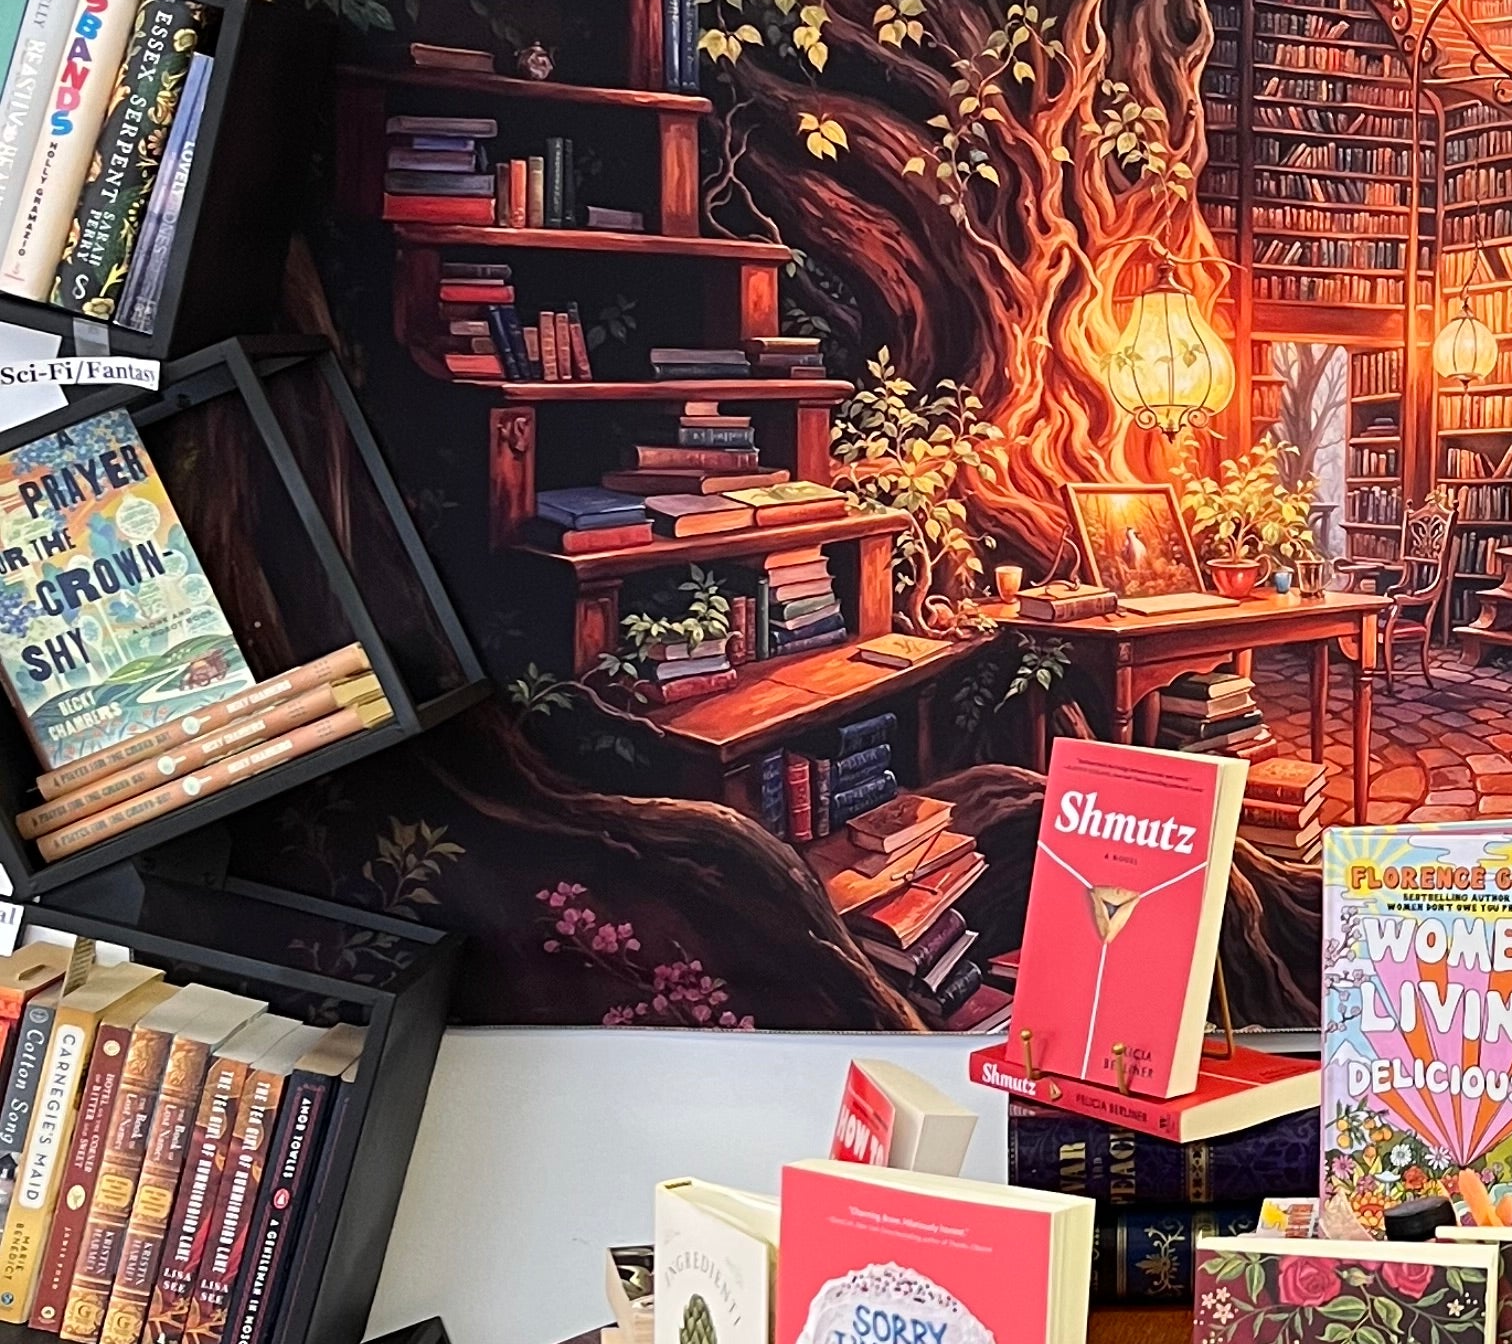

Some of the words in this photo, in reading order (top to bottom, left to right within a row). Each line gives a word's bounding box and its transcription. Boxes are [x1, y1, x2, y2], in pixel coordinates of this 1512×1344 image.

[137, 10, 174, 82] ESSEX
[101, 94, 147, 204] SERPENT
[58, 430, 73, 449] A
[19, 445, 148, 519] PRAYER
[36, 540, 173, 616] CROWN-
[20, 626, 94, 681] SHY
[48, 702, 123, 741] CHAMBERS
[59, 691, 95, 715] BECKY
[1054, 790, 1196, 856] Shmutz
[1351, 866, 1485, 892] FLORENCE
[20, 1030, 45, 1089] Cotton
[982, 1063, 1037, 1096] Shmutz
[38, 1033, 76, 1144] CARNEGIE'S
[0, 1099, 28, 1144] Song
[26, 1155, 48, 1200] MAID
[163, 1267, 192, 1282] LISA
[163, 1281, 186, 1293] SEE
